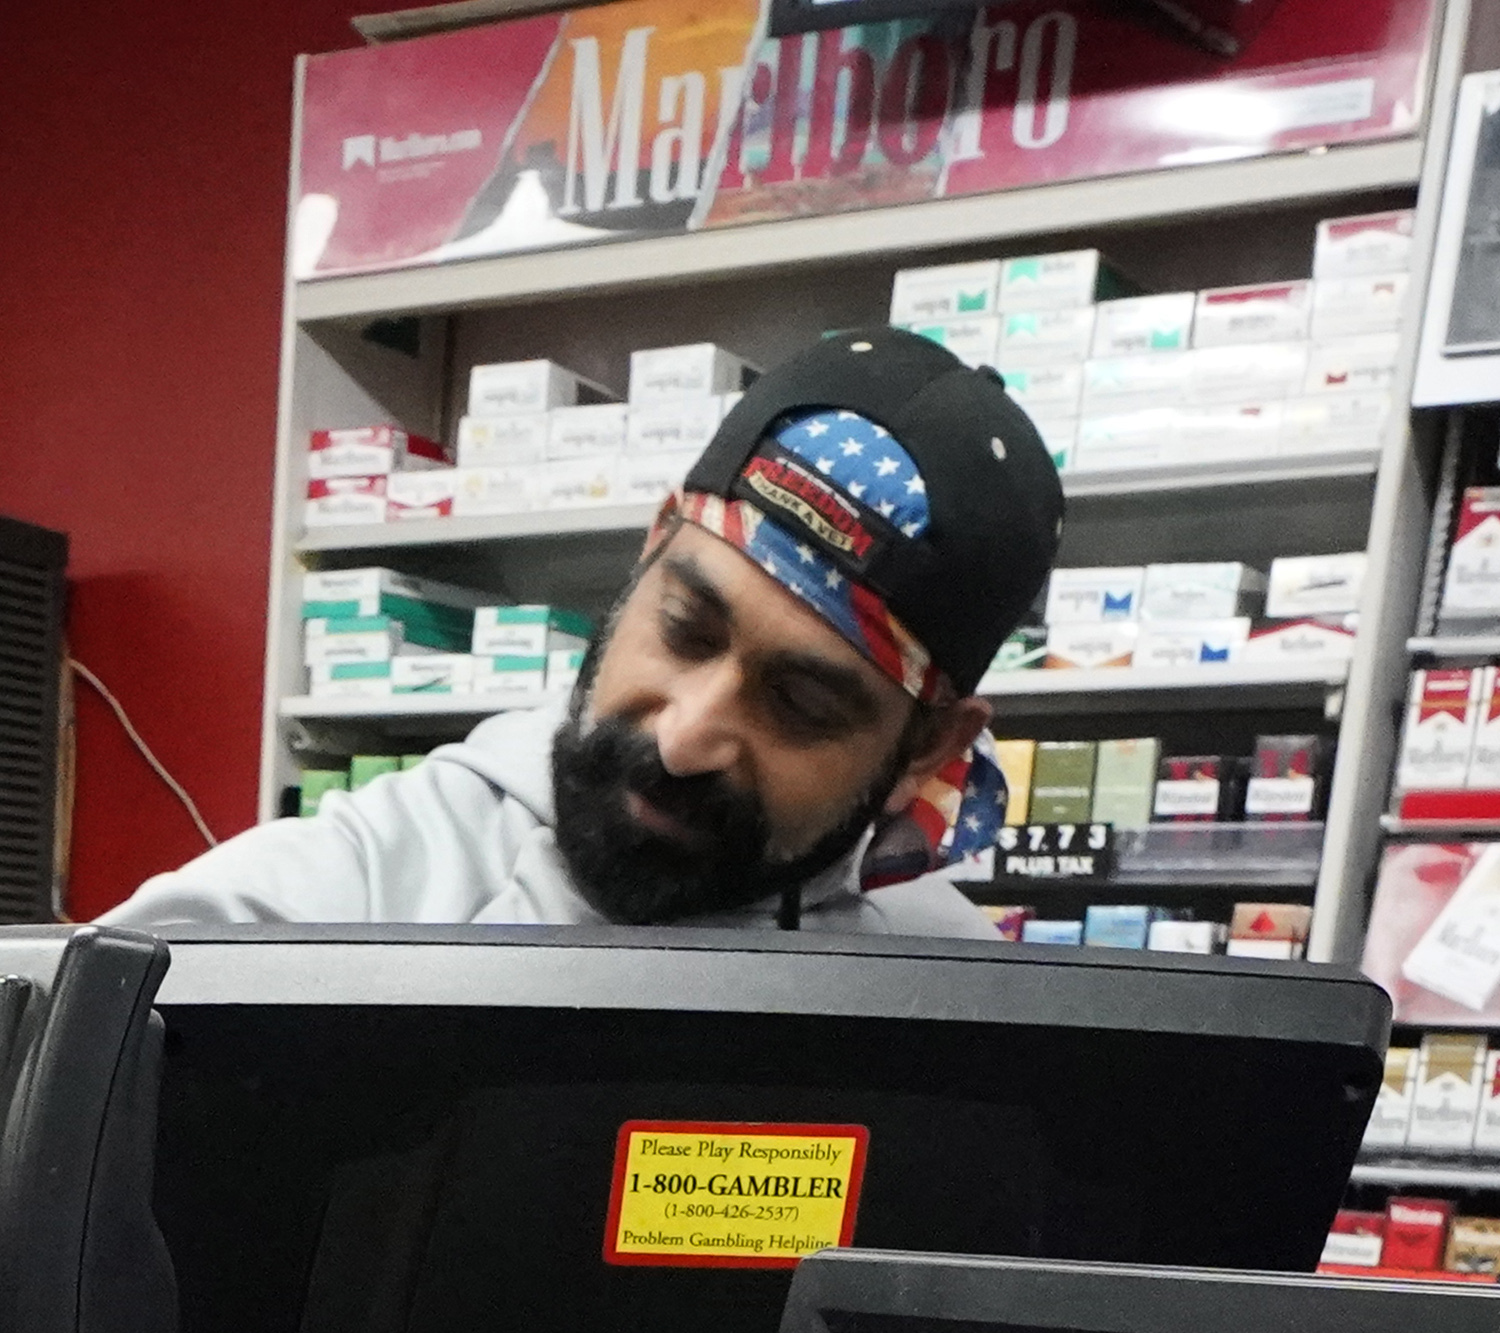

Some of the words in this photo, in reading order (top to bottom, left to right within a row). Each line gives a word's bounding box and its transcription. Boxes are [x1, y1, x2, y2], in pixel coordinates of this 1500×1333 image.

[559, 10, 1079, 217] Marlboro
[1007, 856, 1055, 875] PLUS
[1057, 856, 1094, 875] TAX
[640, 1139, 691, 1157] Please
[697, 1140, 733, 1162] Play
[739, 1142, 841, 1164] Responsibly
[630, 1173, 844, 1199] 1-800-GAMBLER
[664, 1203, 799, 1222] (1-800-426-2537)
[623, 1230, 683, 1247] Problem
[689, 1233, 763, 1253] Gambling
[769, 1235, 832, 1250] Helpline
